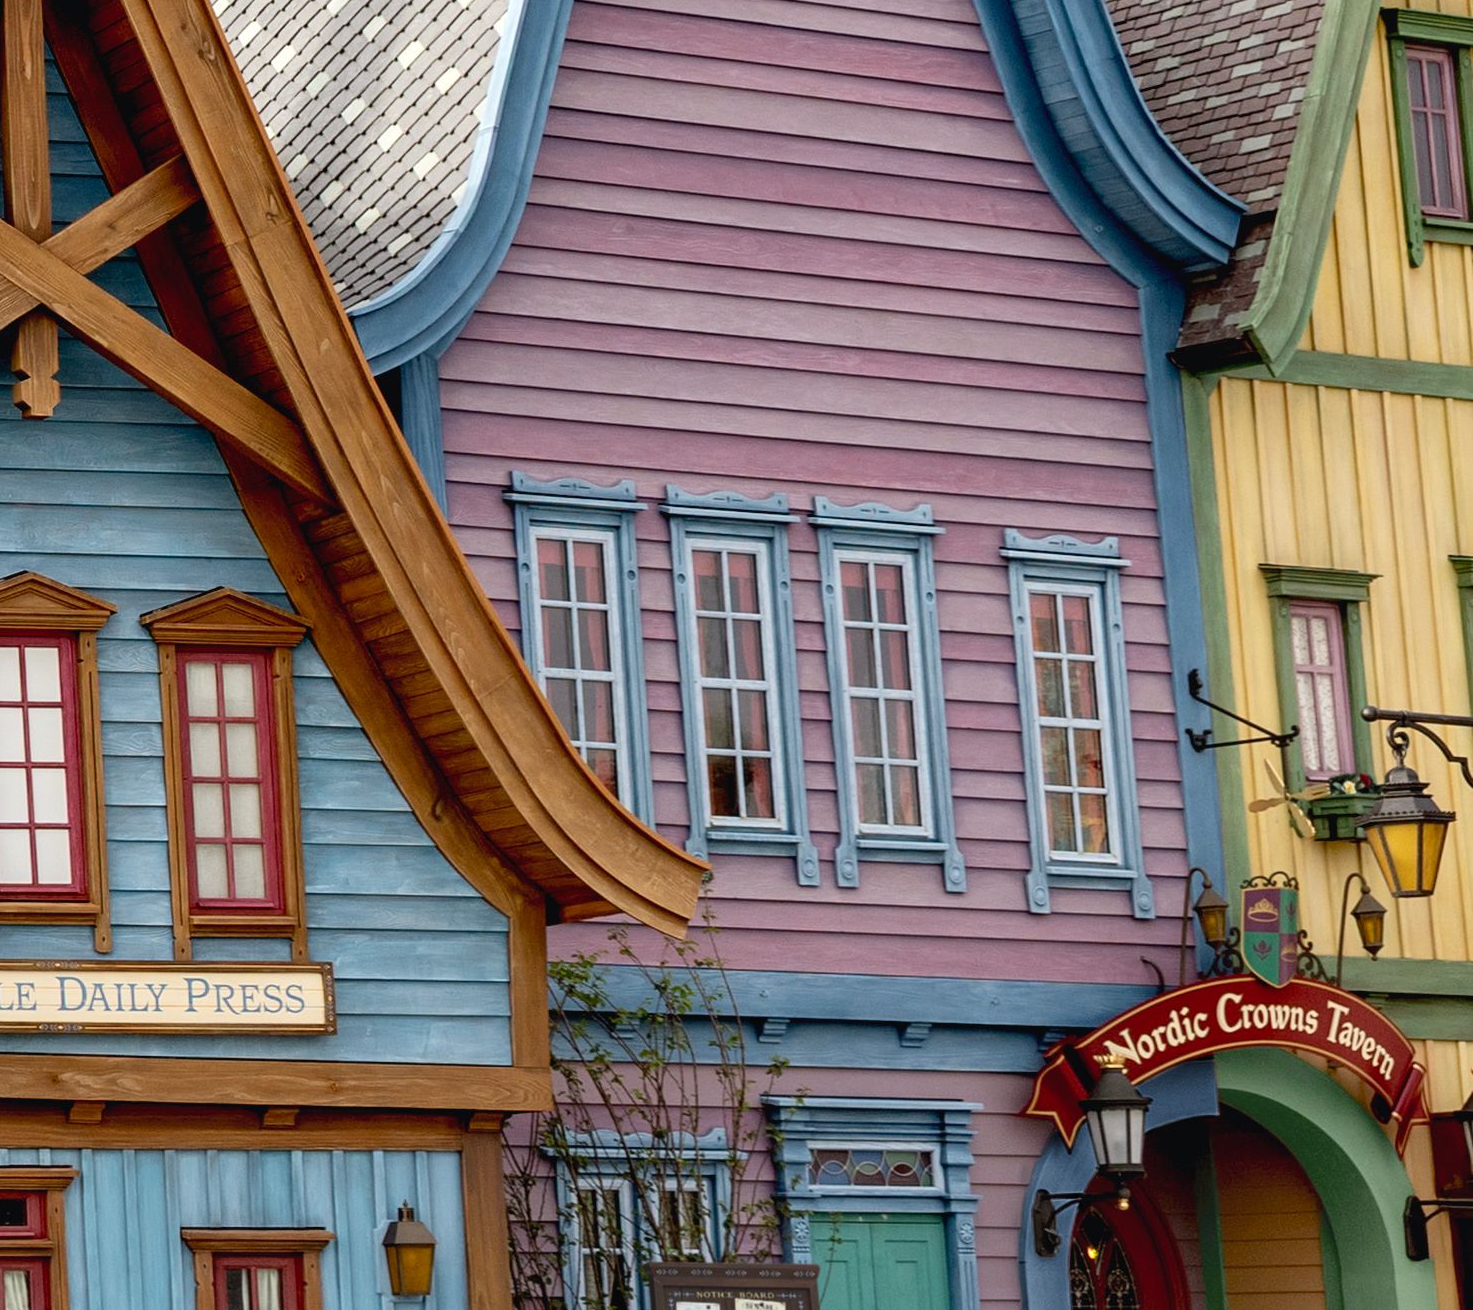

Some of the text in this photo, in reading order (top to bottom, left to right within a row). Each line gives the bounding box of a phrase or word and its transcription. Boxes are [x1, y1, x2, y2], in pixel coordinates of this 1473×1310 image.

[1104, 993, 1396, 1081] Nordic Crowns Tavern
[696, 1291, 776, 1300] NOTICE BOARD
